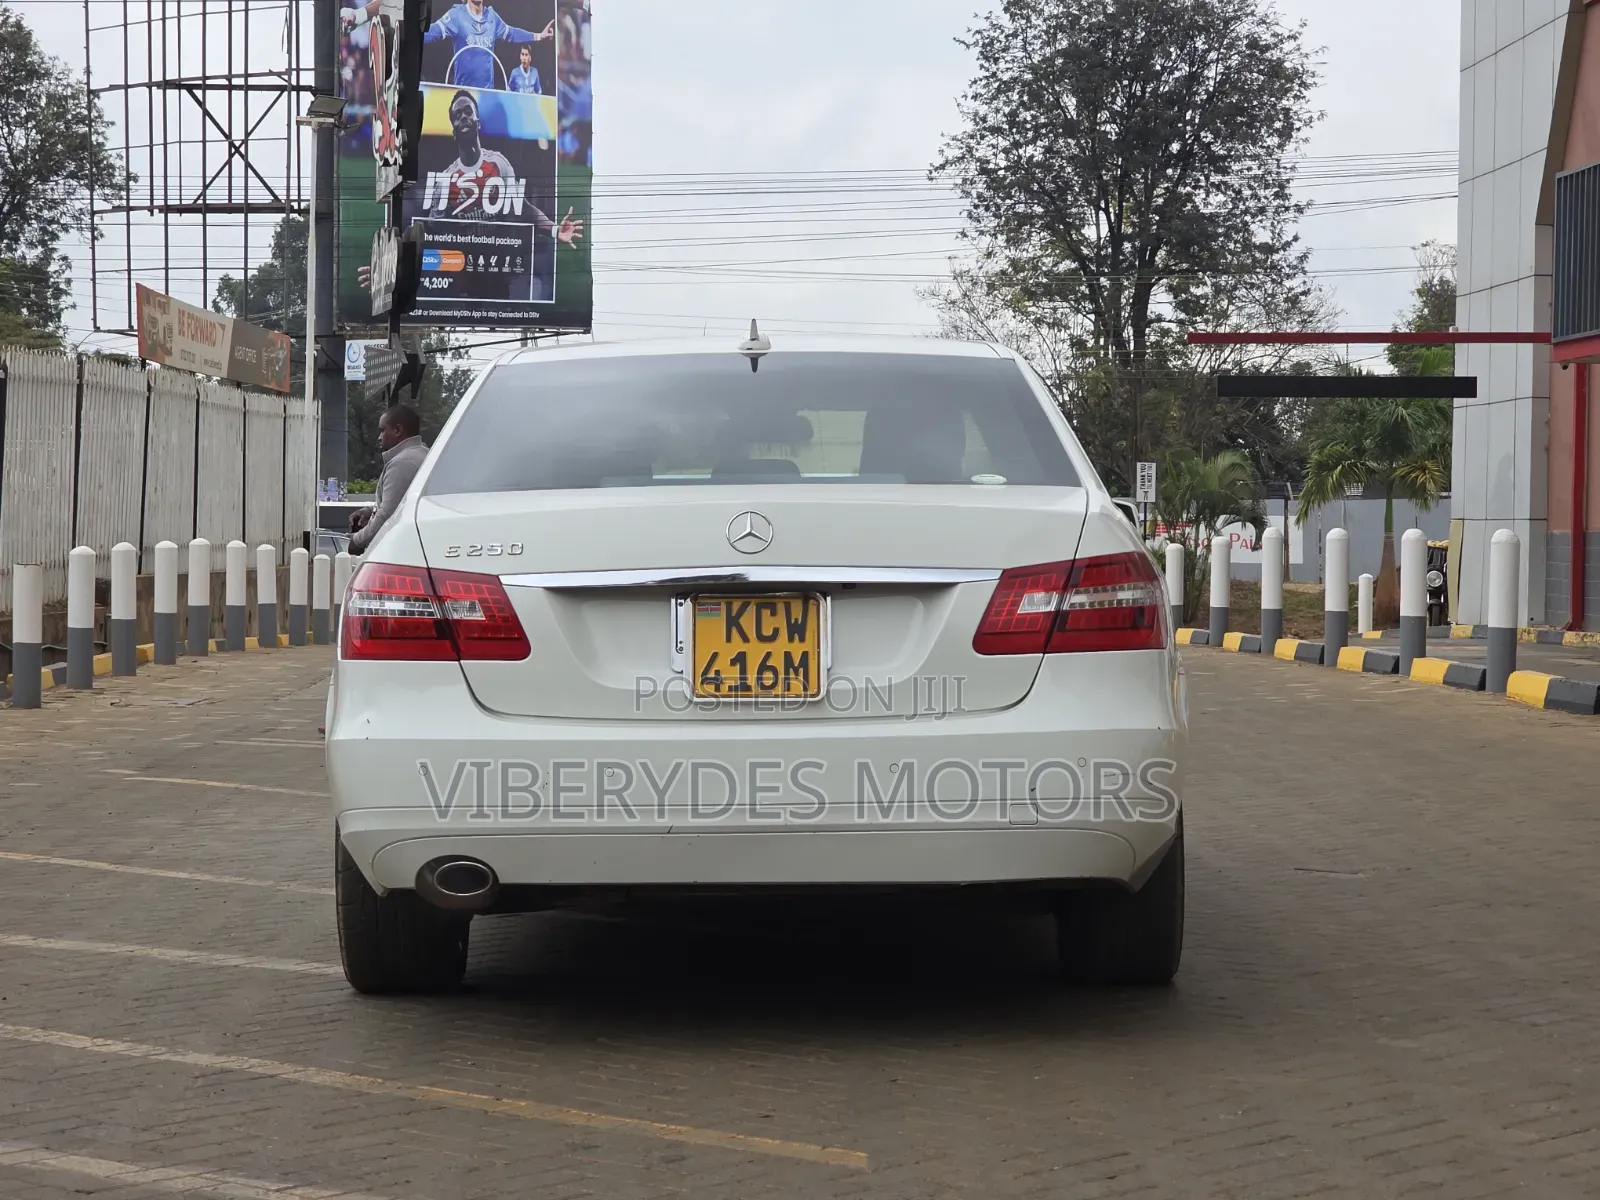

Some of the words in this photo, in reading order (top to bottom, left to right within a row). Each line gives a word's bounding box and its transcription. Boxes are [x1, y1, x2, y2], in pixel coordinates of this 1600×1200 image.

[482, 176, 527, 216] ON
[434, 233, 456, 243] world's
[457, 234, 471, 243] best
[471, 235, 495, 245] football
[496, 236, 522, 247] package
[187, 312, 217, 348] FORWARD
[471, 310, 481, 319] App
[488, 311, 498, 319] stay
[444, 545, 461, 558] E
[466, 542, 524, 557] 250
[725, 601, 809, 644] KCW
[700, 650, 809, 693] 416M
